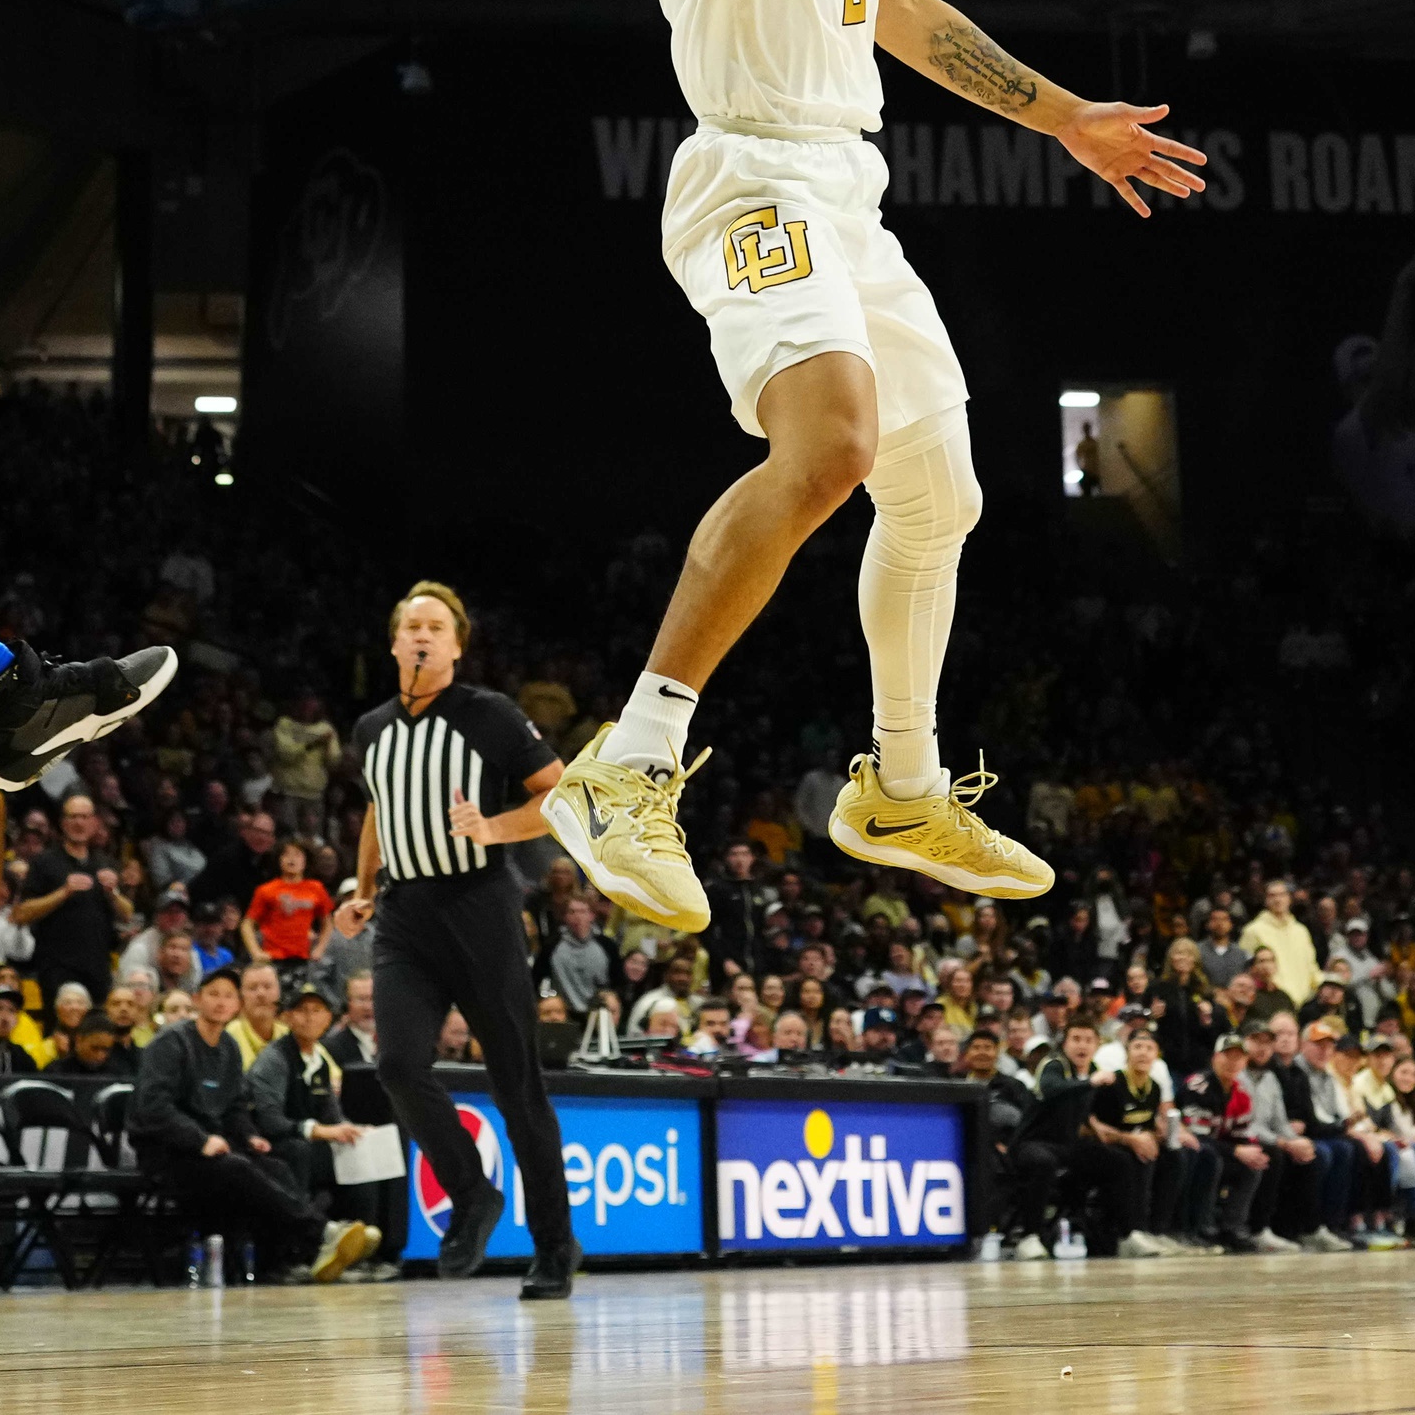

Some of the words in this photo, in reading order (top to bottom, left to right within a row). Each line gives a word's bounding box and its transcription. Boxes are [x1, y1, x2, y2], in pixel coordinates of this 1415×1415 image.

[877, 121, 1245, 212] HAMPS
[722, 205, 813, 294] CU
[514, 1128, 680, 1226] epsi
[719, 1135, 966, 1240] nextiva
